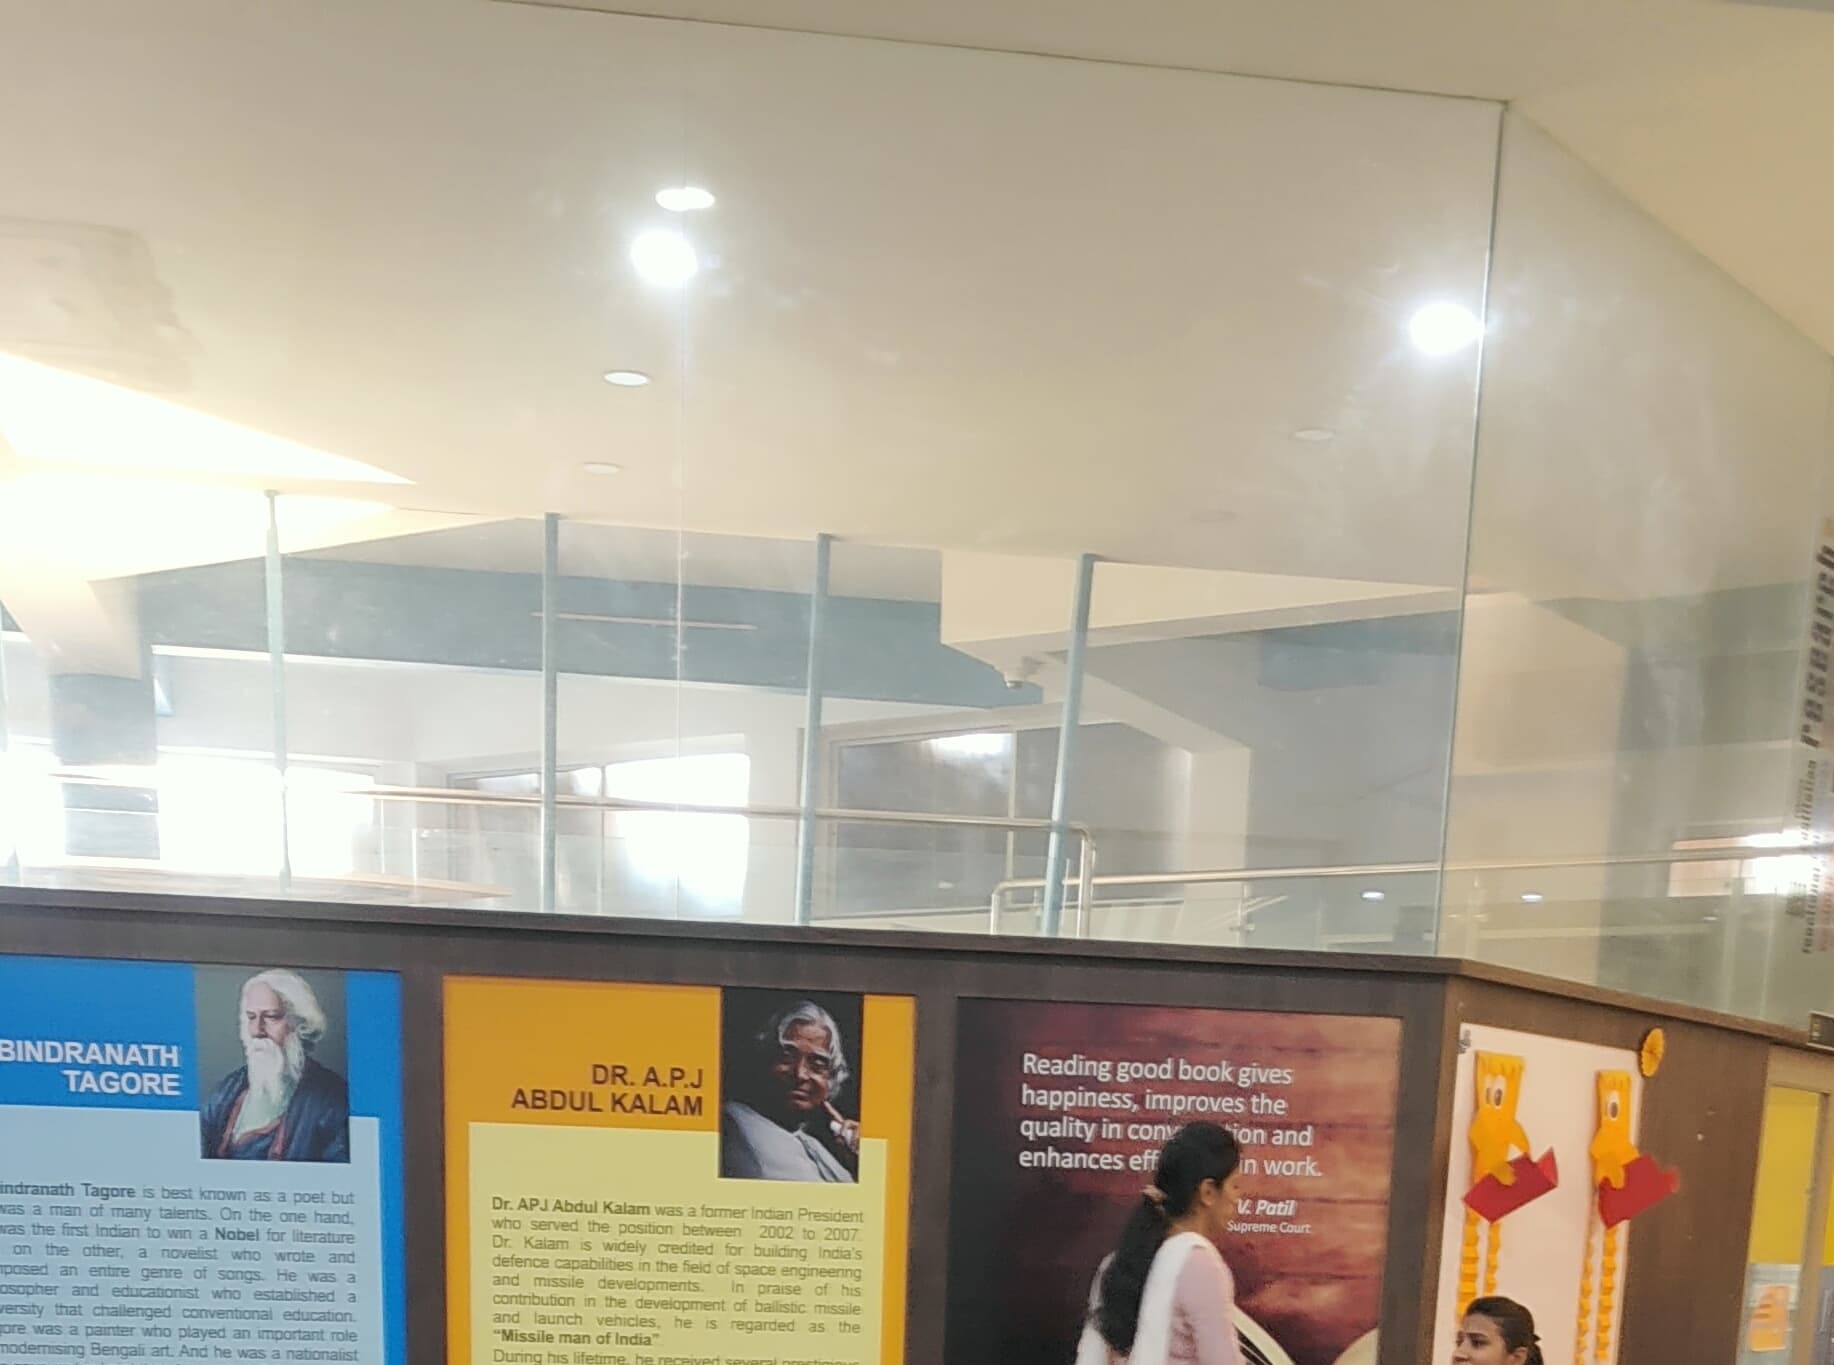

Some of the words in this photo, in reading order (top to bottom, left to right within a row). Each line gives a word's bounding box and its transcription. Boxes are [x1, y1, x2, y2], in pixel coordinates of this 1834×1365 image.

[0, 1039, 180, 1067] BINDRANATH
[591, 1063, 635, 1087] DR.
[642, 1066, 704, 1089] A.P.J
[1023, 1053, 1113, 1082] Reading
[1116, 1058, 1174, 1083] good
[1178, 1058, 1234, 1082] book
[1237, 1062, 1294, 1087] gives
[60, 1069, 182, 1096] TAGORE
[511, 1087, 603, 1112] ABDUL
[610, 1092, 703, 1116] KALAM
[1021, 1083, 1139, 1113] happiness,
[1145, 1089, 1245, 1115] improves
[1251, 1093, 1288, 1114] the
[1020, 1116, 1096, 1143] quality
[1101, 1118, 1122, 1139] in
[1271, 1125, 1315, 1146] and
[1019, 1146, 1125, 1171] enhances
[1263, 1156, 1323, 1177] work.
[81, 1183, 137, 1201] Tagore
[161, 1185, 193, 1200] best
[199, 1186, 247, 1201] known
[292, 1189, 326, 1207] poet
[110, 1206, 152, 1221] many
[491, 1196, 514, 1211] Dr.
[516, 1197, 549, 1212] APJ
[551, 1198, 599, 1214] Abdul
[602, 1200, 652, 1216] Kalam
[654, 1205, 684, 1217] was
[700, 1204, 749, 1219] former
[751, 1206, 794, 1221] Indian
[797, 1208, 865, 1223] President
[1255, 1200, 1298, 1216] Patil
[61, 1222, 90, 1237] first
[95, 1223, 141, 1238] Indian
[214, 1226, 260, 1241] Nobel
[292, 1228, 356, 1244] literature
[490, 1215, 522, 1230] who
[530, 1216, 580, 1232] served
[587, 1218, 611, 1233] the
[618, 1219, 675, 1238] position
[682, 1221, 742, 1237] between
[758, 1224, 795, 1239] 2002
[1226, 1220, 1278, 1234] Supreme
[1279, 1221, 1312, 1234] Court
[161, 1245, 219, 1260] novelist
[274, 1247, 316, 1263] wrote
[491, 1234, 513, 1249] Dr.
[523, 1235, 571, 1250] Kalam
[601, 1237, 648, 1256] widely
[657, 1239, 715, 1255] credited
[724, 1241, 745, 1256] for
[753, 1243, 808, 1261] building
[88, 1263, 131, 1278] entire
[140, 1268, 184, 1283] genre
[217, 1270, 266, 1285] songs.
[491, 1253, 550, 1268] defence
[553, 1255, 634, 1274] capabilities
[655, 1258, 679, 1273] the
[682, 1259, 712, 1274] field
[734, 1264, 777, 1279] space
[780, 1262, 863, 1282] engineering
[111, 1283, 199, 1299] educationist
[253, 1287, 335, 1302] established
[492, 1271, 521, 1286] and
[533, 1273, 585, 1288] missile
[597, 1275, 705, 1295] developments.
[757, 1280, 802, 1298] praise
[841, 1282, 862, 1297] his
[54, 1301, 83, 1316] that
[92, 1302, 172, 1321] challenged
[182, 1304, 273, 1320] conventional
[282, 1307, 356, 1322] education.
[492, 1290, 577, 1306] contribution
[604, 1293, 628, 1308] the
[634, 1295, 728, 1314] development
[754, 1298, 807, 1314] ballistic
[813, 1300, 863, 1315] missile
[84, 1322, 136, 1340] painter
[178, 1324, 227, 1342] played
[257, 1326, 325, 1344] important
[330, 1327, 358, 1342] role
[491, 1309, 521, 1324] and
[533, 1310, 584, 1325] launch
[730, 1316, 796, 1334] regarded
[838, 1319, 862, 1334] the
[558, 1332, 592, 1344] man
[90, 1341, 146, 1360] Bengali
[150, 1343, 175, 1357] art.
[179, 1343, 209, 1358] And
[285, 1346, 359, 1361] nationalist
[492, 1348, 543, 1365] During
[547, 1350, 569, 1364] his
